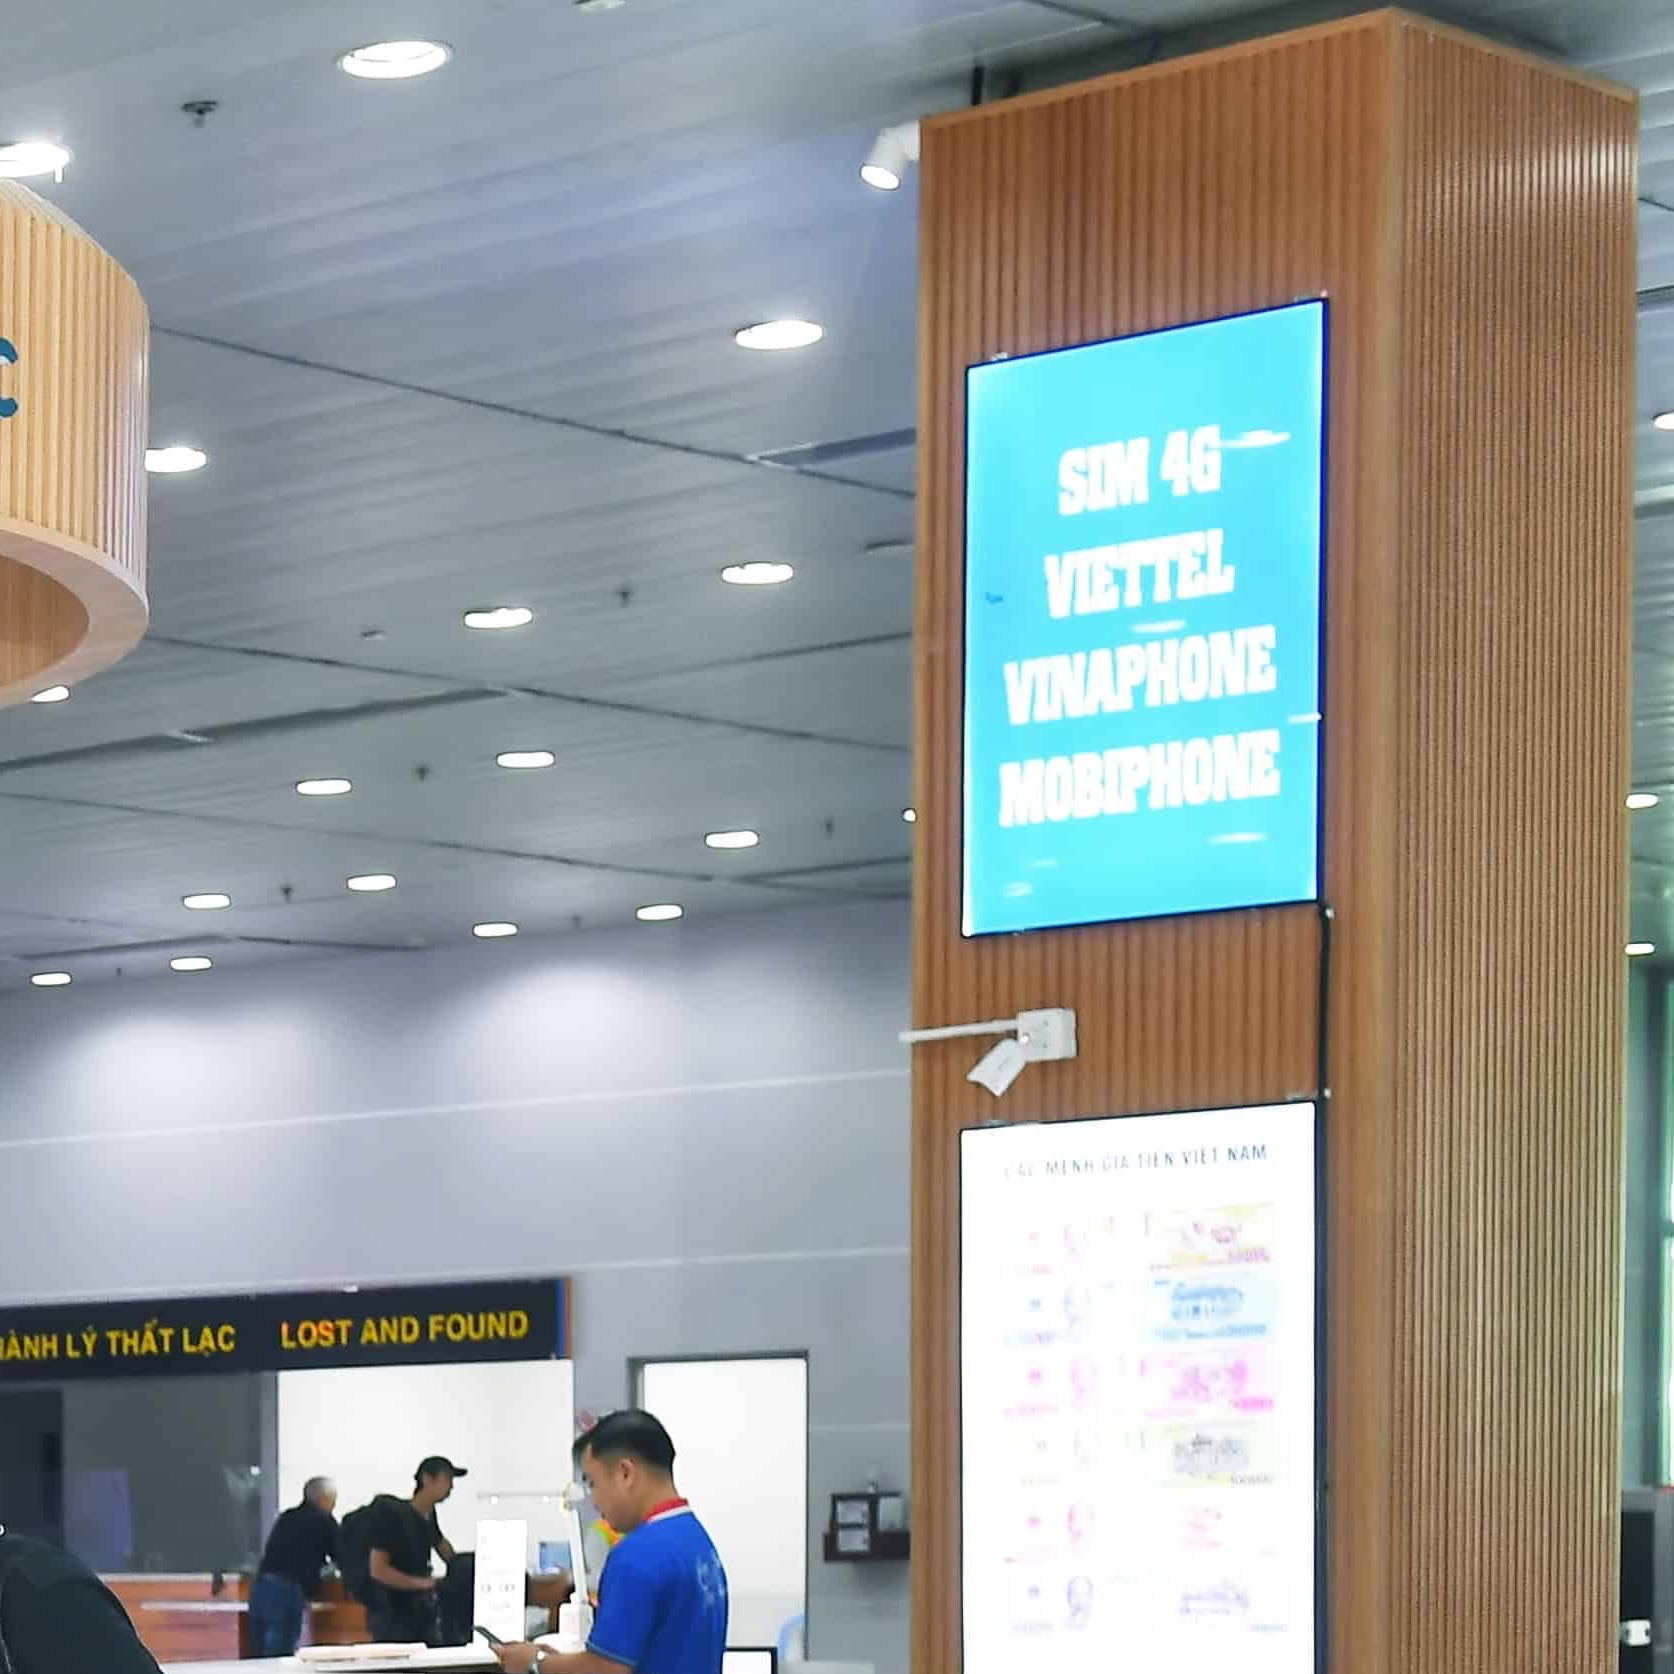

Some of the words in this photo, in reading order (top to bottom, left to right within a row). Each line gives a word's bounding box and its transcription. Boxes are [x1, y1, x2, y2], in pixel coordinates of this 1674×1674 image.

[1059, 437, 1149, 516] SIM
[1160, 424, 1221, 497] 4G
[1044, 528, 1235, 619] VIETTEL
[1003, 624, 1276, 726] VINAPHONE
[999, 729, 1281, 828] MOBIPHONE
[66, 1324, 98, 1359] LÝ
[107, 1317, 175, 1357] THẤT
[182, 1323, 236, 1358] LẠC
[280, 1317, 352, 1349] LOST
[359, 1315, 421, 1345] AND
[428, 1310, 529, 1342] FOUND
